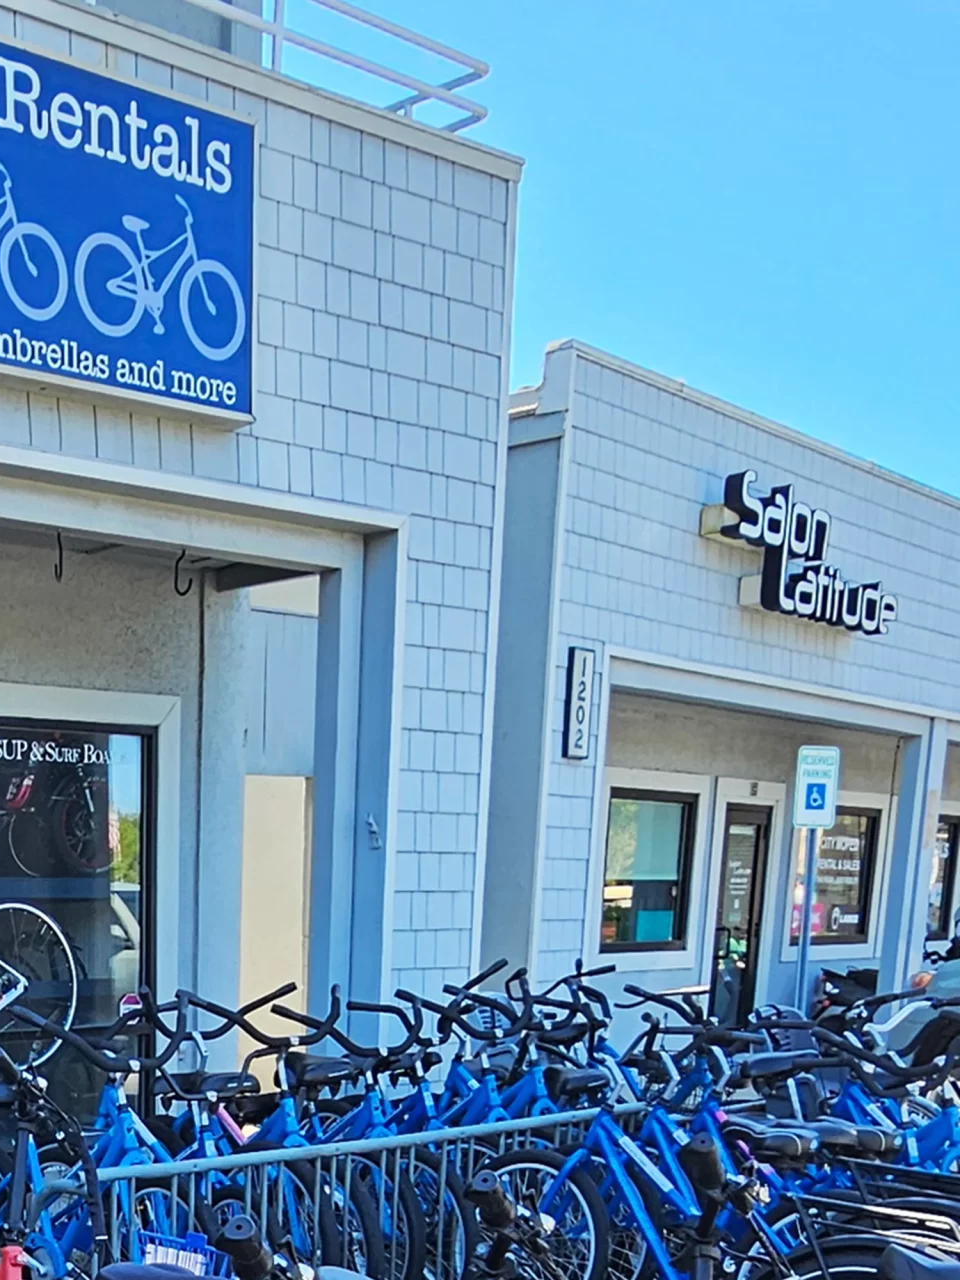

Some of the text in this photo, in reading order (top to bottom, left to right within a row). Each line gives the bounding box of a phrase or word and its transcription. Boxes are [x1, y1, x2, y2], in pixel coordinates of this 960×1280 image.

[116, 359, 167, 392] and
[170, 368, 237, 405] more
[739, 469, 831, 561] Salon
[778, 545, 898, 634] Latitude
[29, 741, 44, 761] &
[45, 741, 81, 763] SURF
